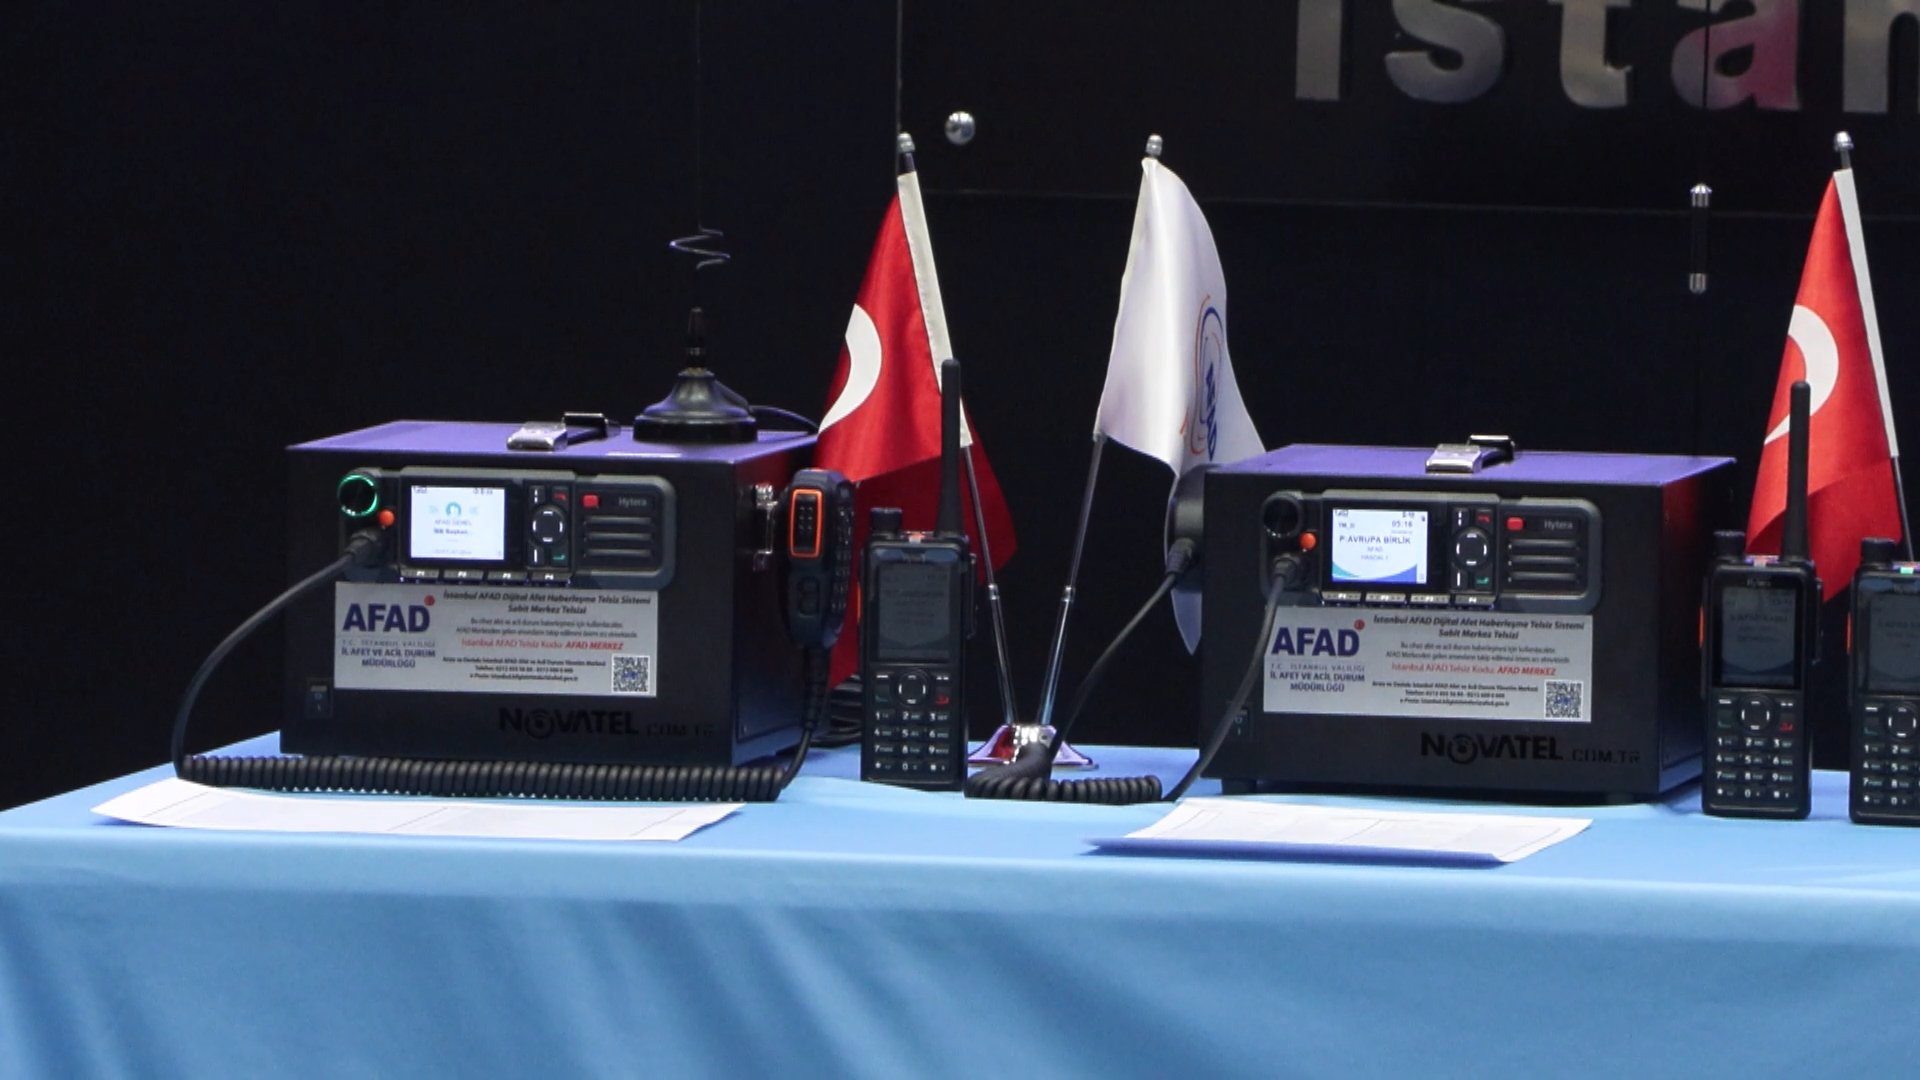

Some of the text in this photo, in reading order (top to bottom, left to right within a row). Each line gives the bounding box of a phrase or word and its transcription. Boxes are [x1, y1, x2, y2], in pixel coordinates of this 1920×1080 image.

[618, 496, 648, 509] Hytera
[1544, 519, 1573, 531] Hytera
[443, 588, 478, 600] İstanbul
[479, 592, 501, 600] AFAD
[502, 592, 528, 602] Dijital
[598, 595, 619, 603] Telsiz
[621, 596, 651, 604] Sistemi
[508, 604, 529, 612] Sabit
[530, 604, 560, 613] Merkez
[342, 603, 430, 632] AFAD
[1373, 614, 1408, 624] İstanbul
[1409, 616, 1432, 625] AFAD
[1433, 617, 1459, 627] Dijital
[1460, 618, 1478, 626] Afet
[1530, 620, 1552, 629] Telsiz
[1554, 621, 1585, 630] Sistemi
[1439, 629, 1519, 639] Sabit Merkez Telsizi
[462, 637, 494, 647] İstanbul
[495, 640, 518, 648] AFAD
[565, 641, 588, 649] AFAD
[590, 641, 624, 650] MERKEZ
[1271, 627, 1360, 657] AFAD
[350, 648, 370, 656] AFET
[372, 648, 382, 656] VE
[405, 649, 436, 657] DURUM
[1392, 662, 1425, 671] İstanbul
[1426, 663, 1448, 672] AFAD
[1449, 664, 1471, 673] Telsiz
[1497, 666, 1520, 674] AFAD
[1521, 666, 1557, 676] MERKEZ
[1279, 672, 1299, 680] AFET
[1301, 672, 1311, 681] VE
[1313, 672, 1331, 682] ACİL
[1333, 673, 1366, 682] DURUM
[498, 706, 640, 739] NOVATEL
[1420, 732, 1563, 764] NOVATEL
